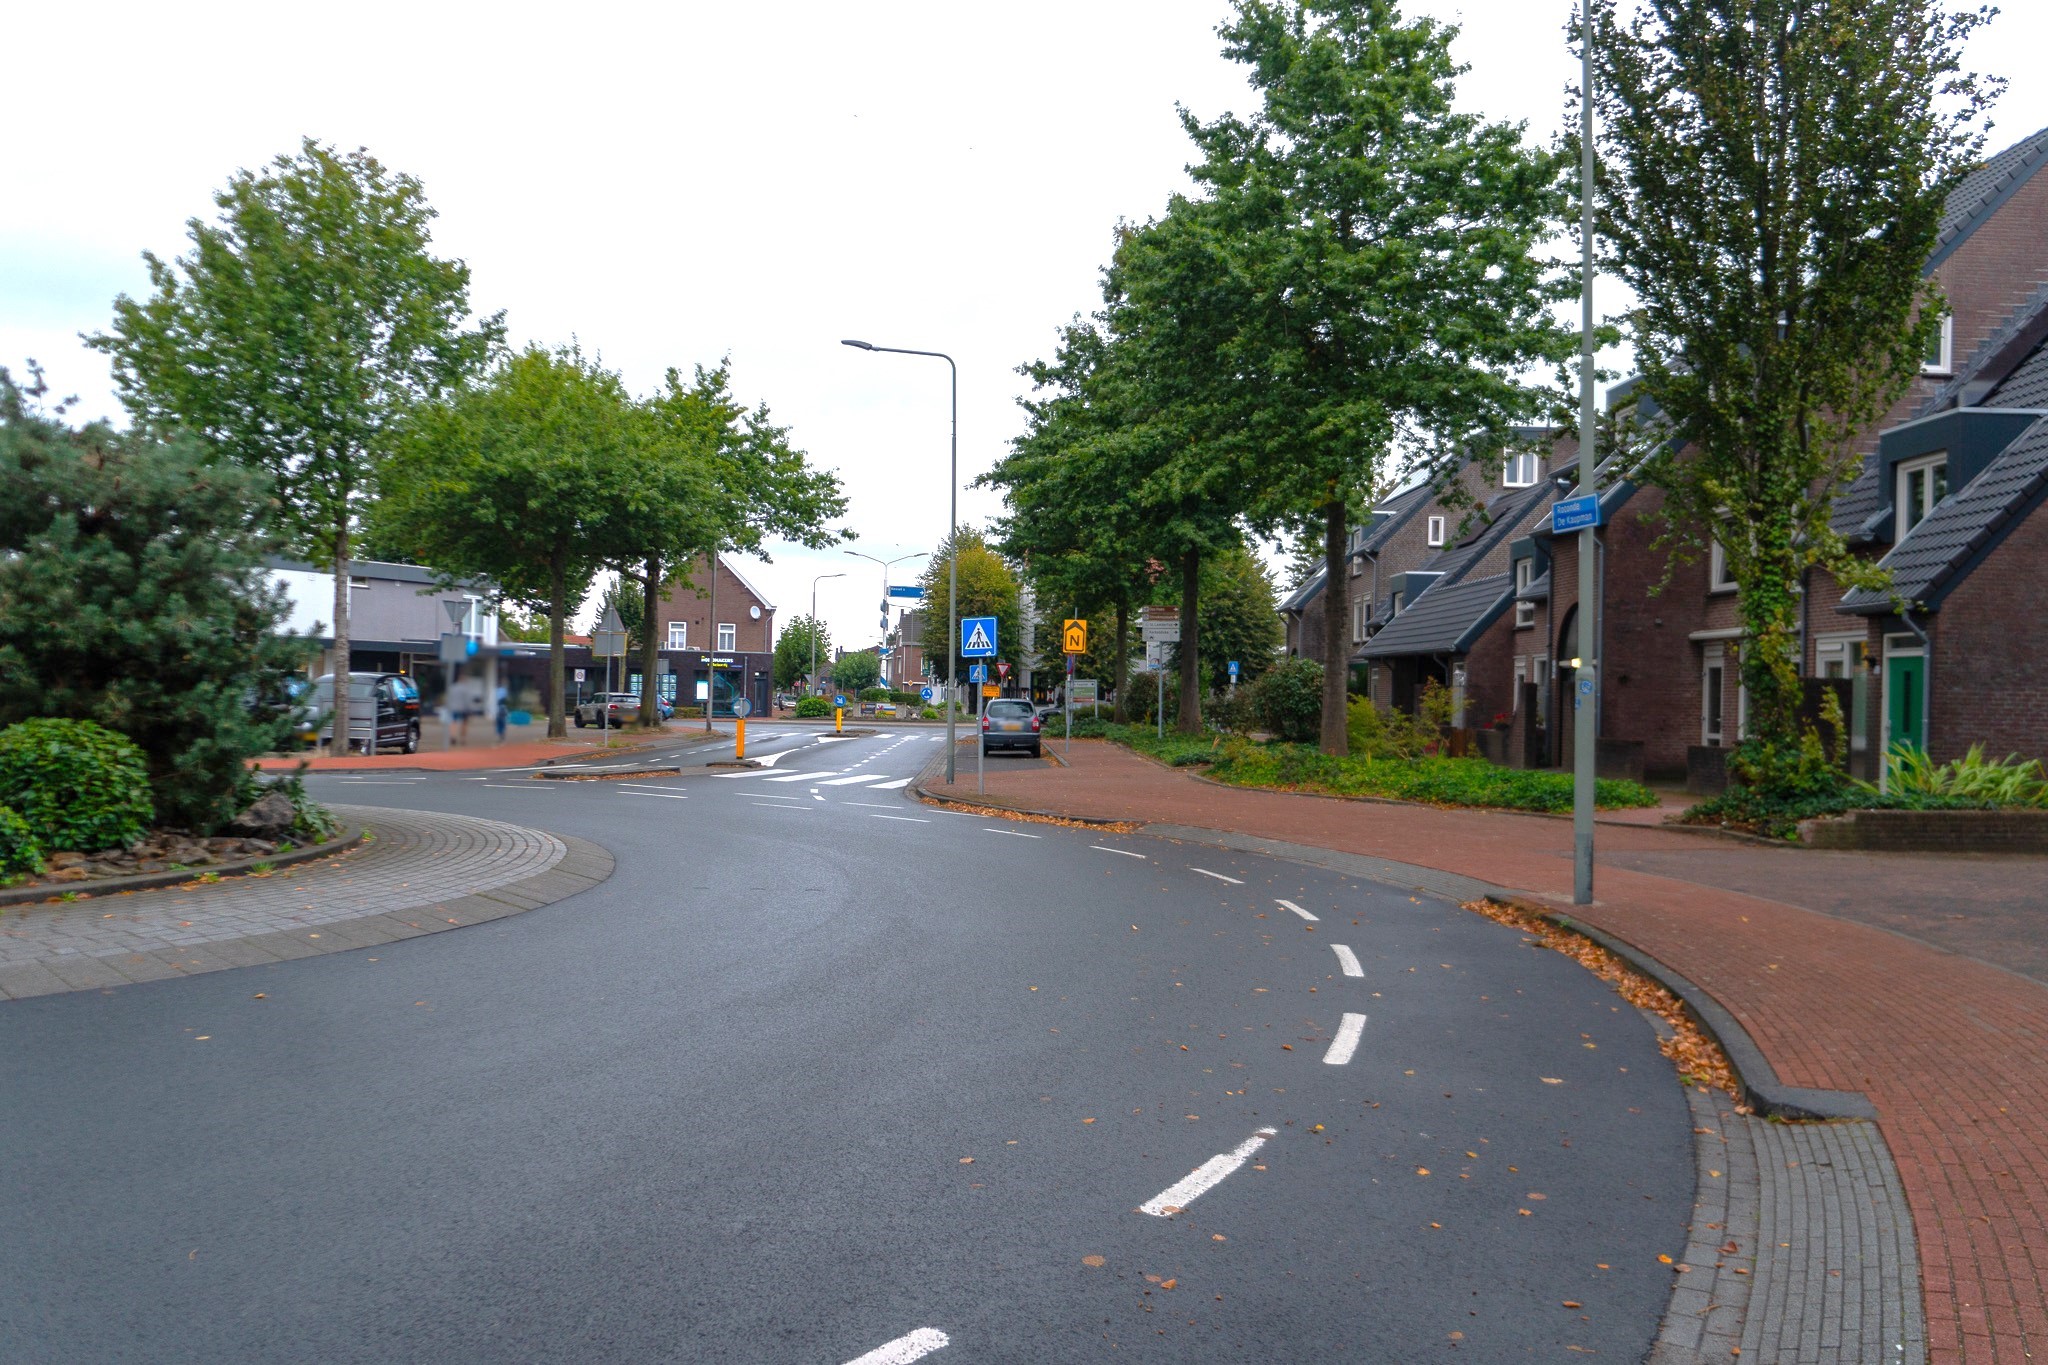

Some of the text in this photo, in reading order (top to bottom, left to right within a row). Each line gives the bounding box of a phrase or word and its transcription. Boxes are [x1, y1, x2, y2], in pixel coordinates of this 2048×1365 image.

[1557, 503, 1580, 514] Rotonde
[1557, 517, 1565, 526] De
[1070, 635, 1080, 646] N
